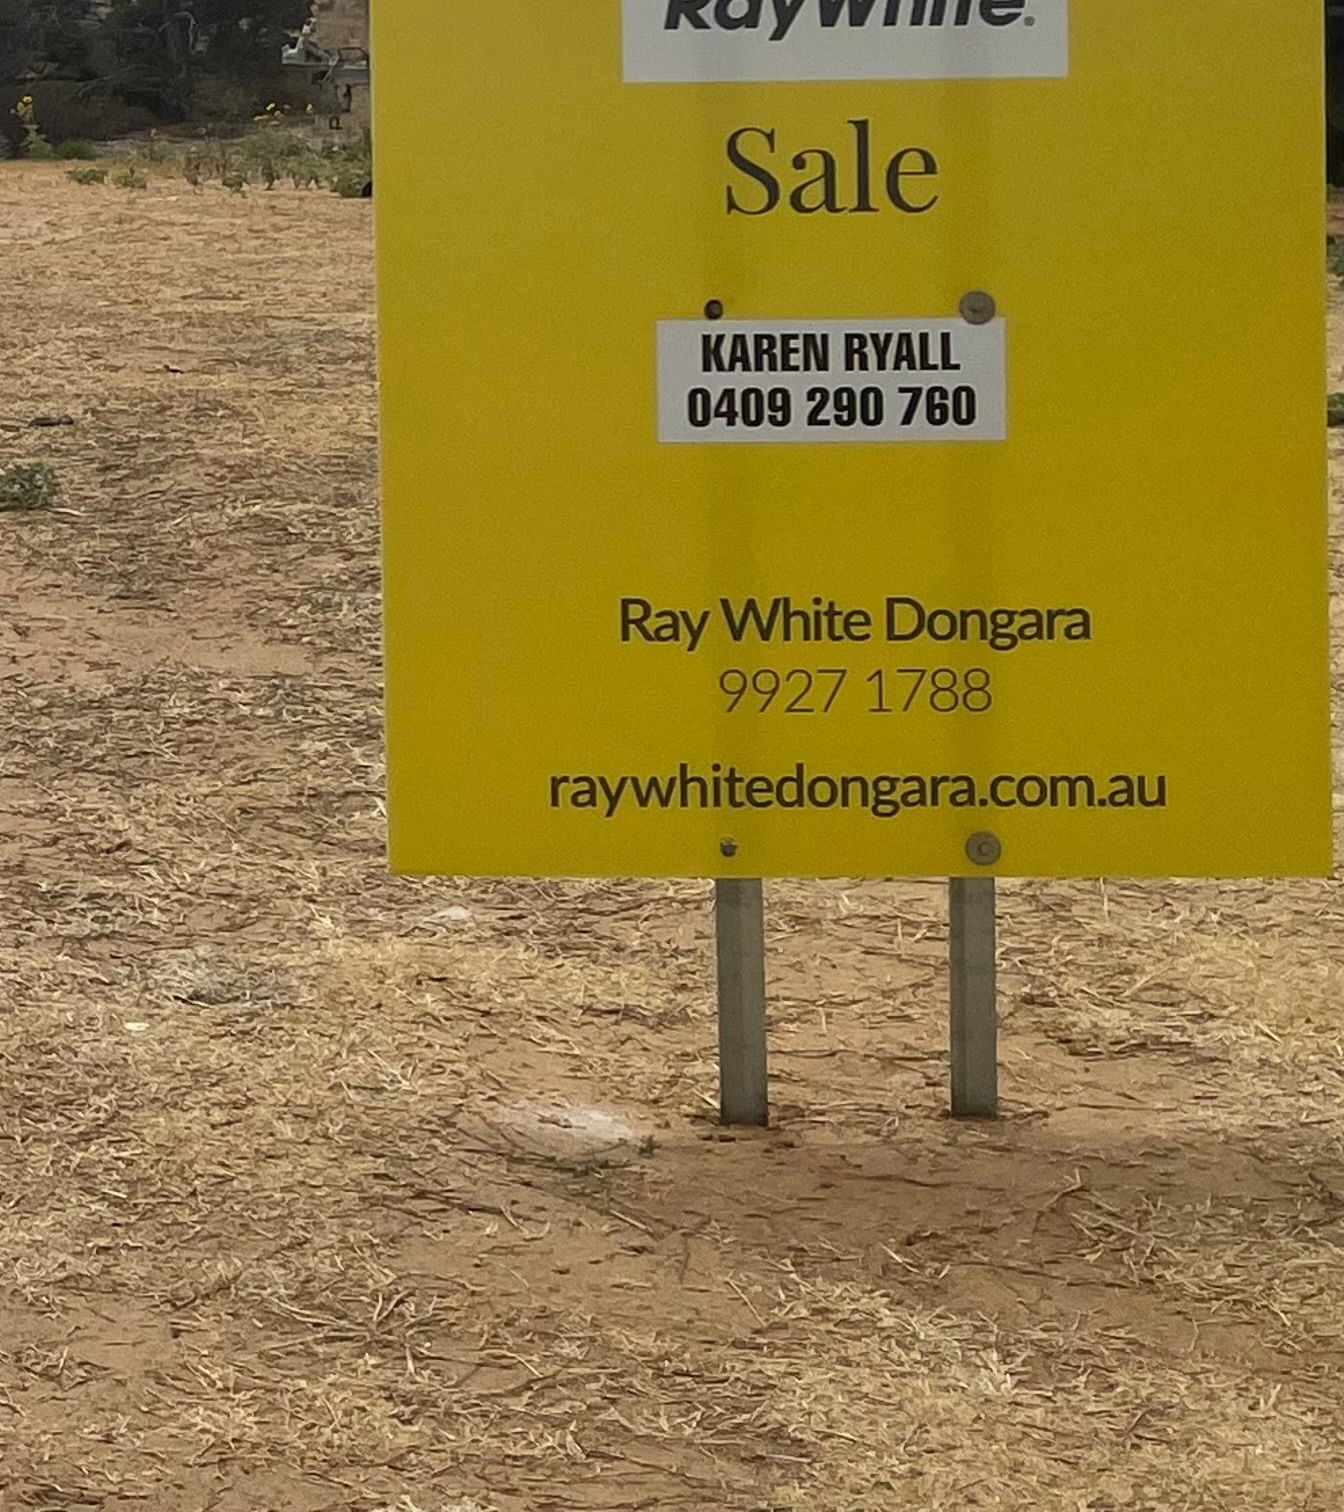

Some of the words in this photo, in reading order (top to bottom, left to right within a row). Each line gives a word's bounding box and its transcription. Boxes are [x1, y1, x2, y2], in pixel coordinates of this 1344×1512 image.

[726, 118, 939, 216] Sale
[701, 333, 830, 373] KAREN
[844, 331, 961, 372] RYALL
[687, 387, 792, 428] 0409
[806, 386, 884, 427] 290
[897, 385, 976, 426] 760
[620, 598, 711, 652] Ray
[719, 596, 872, 642] White
[886, 597, 1091, 651] Dongara
[719, 668, 848, 713] 9927
[866, 667, 992, 713] 1788
[550, 762, 1167, 818] raywhitedongara.com.au
